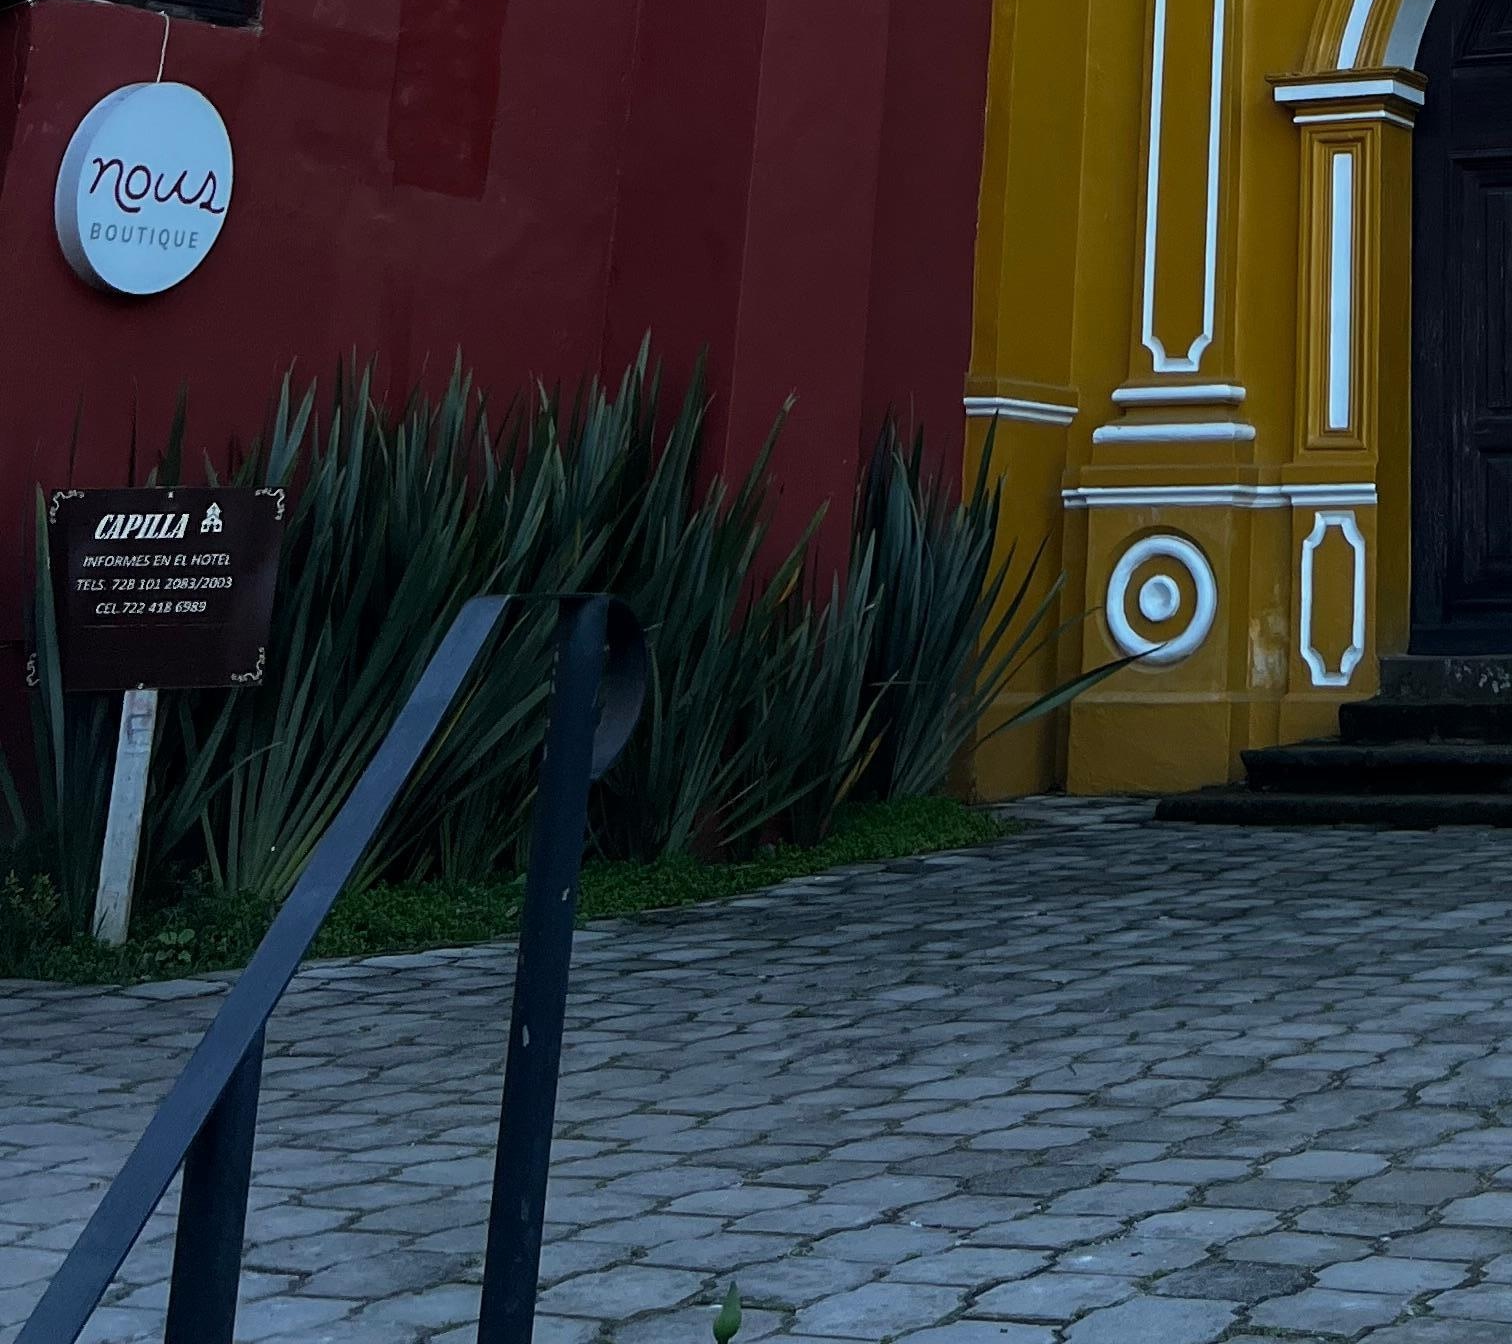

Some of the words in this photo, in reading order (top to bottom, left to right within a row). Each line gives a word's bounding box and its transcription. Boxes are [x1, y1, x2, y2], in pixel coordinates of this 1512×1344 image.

[89, 157, 225, 214] nous
[90, 222, 200, 251] BOUTIQUE
[94, 514, 190, 539] CAPILLA
[82, 555, 151, 567] INFORMES
[153, 554, 171, 566] EN
[173, 553, 188, 566] EL
[190, 552, 232, 566] HOTEL
[76, 578, 107, 591] TELS.
[111, 578, 136, 591] 728
[137, 577, 161, 591] 101
[148, 600, 173, 614] 418
